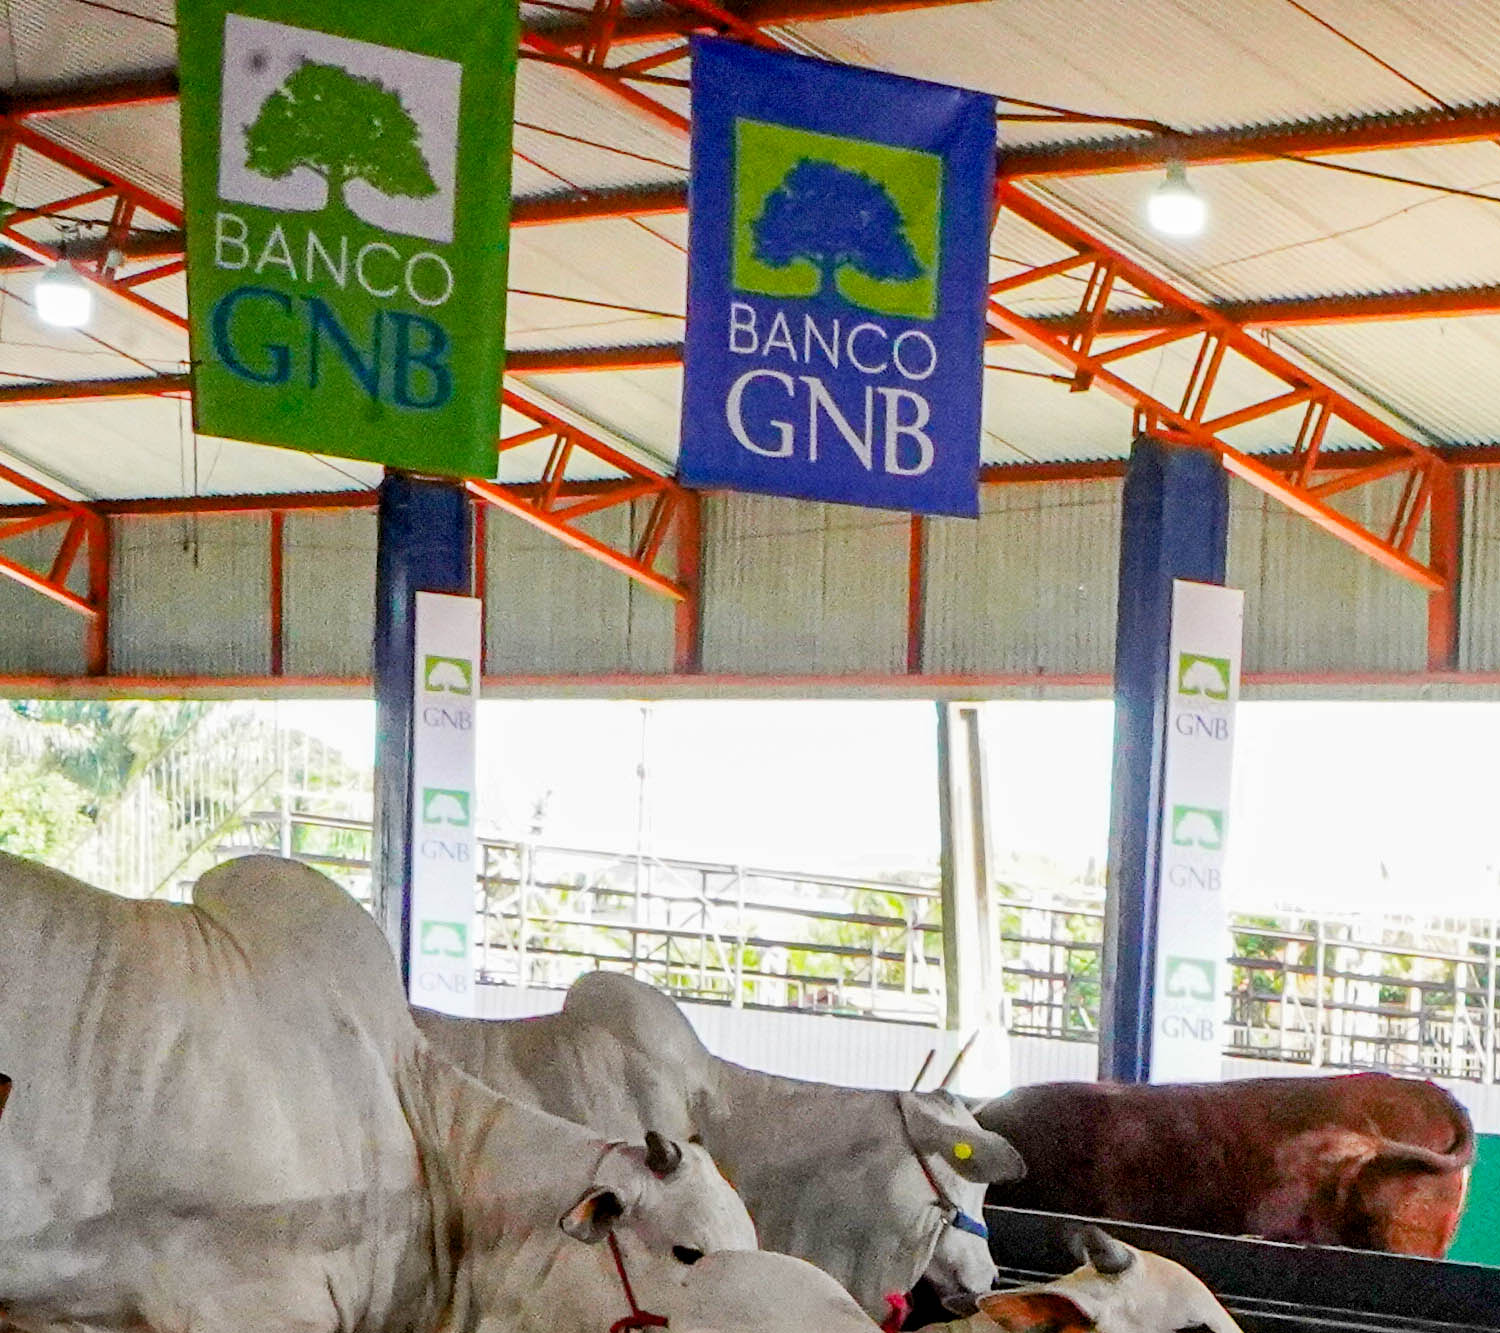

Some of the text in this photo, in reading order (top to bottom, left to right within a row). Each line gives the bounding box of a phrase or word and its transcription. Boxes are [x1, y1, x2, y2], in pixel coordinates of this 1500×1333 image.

[214, 211, 454, 307] BANCO
[211, 286, 454, 411] GNB
[727, 301, 937, 382] BANCO
[725, 368, 937, 477] GNB
[423, 707, 472, 731] GNB
[1175, 713, 1229, 741] GNB
[421, 839, 471, 864] GNB
[1169, 864, 1222, 891] GNB
[418, 970, 468, 994] GNB
[1161, 1014, 1215, 1041] GNB
